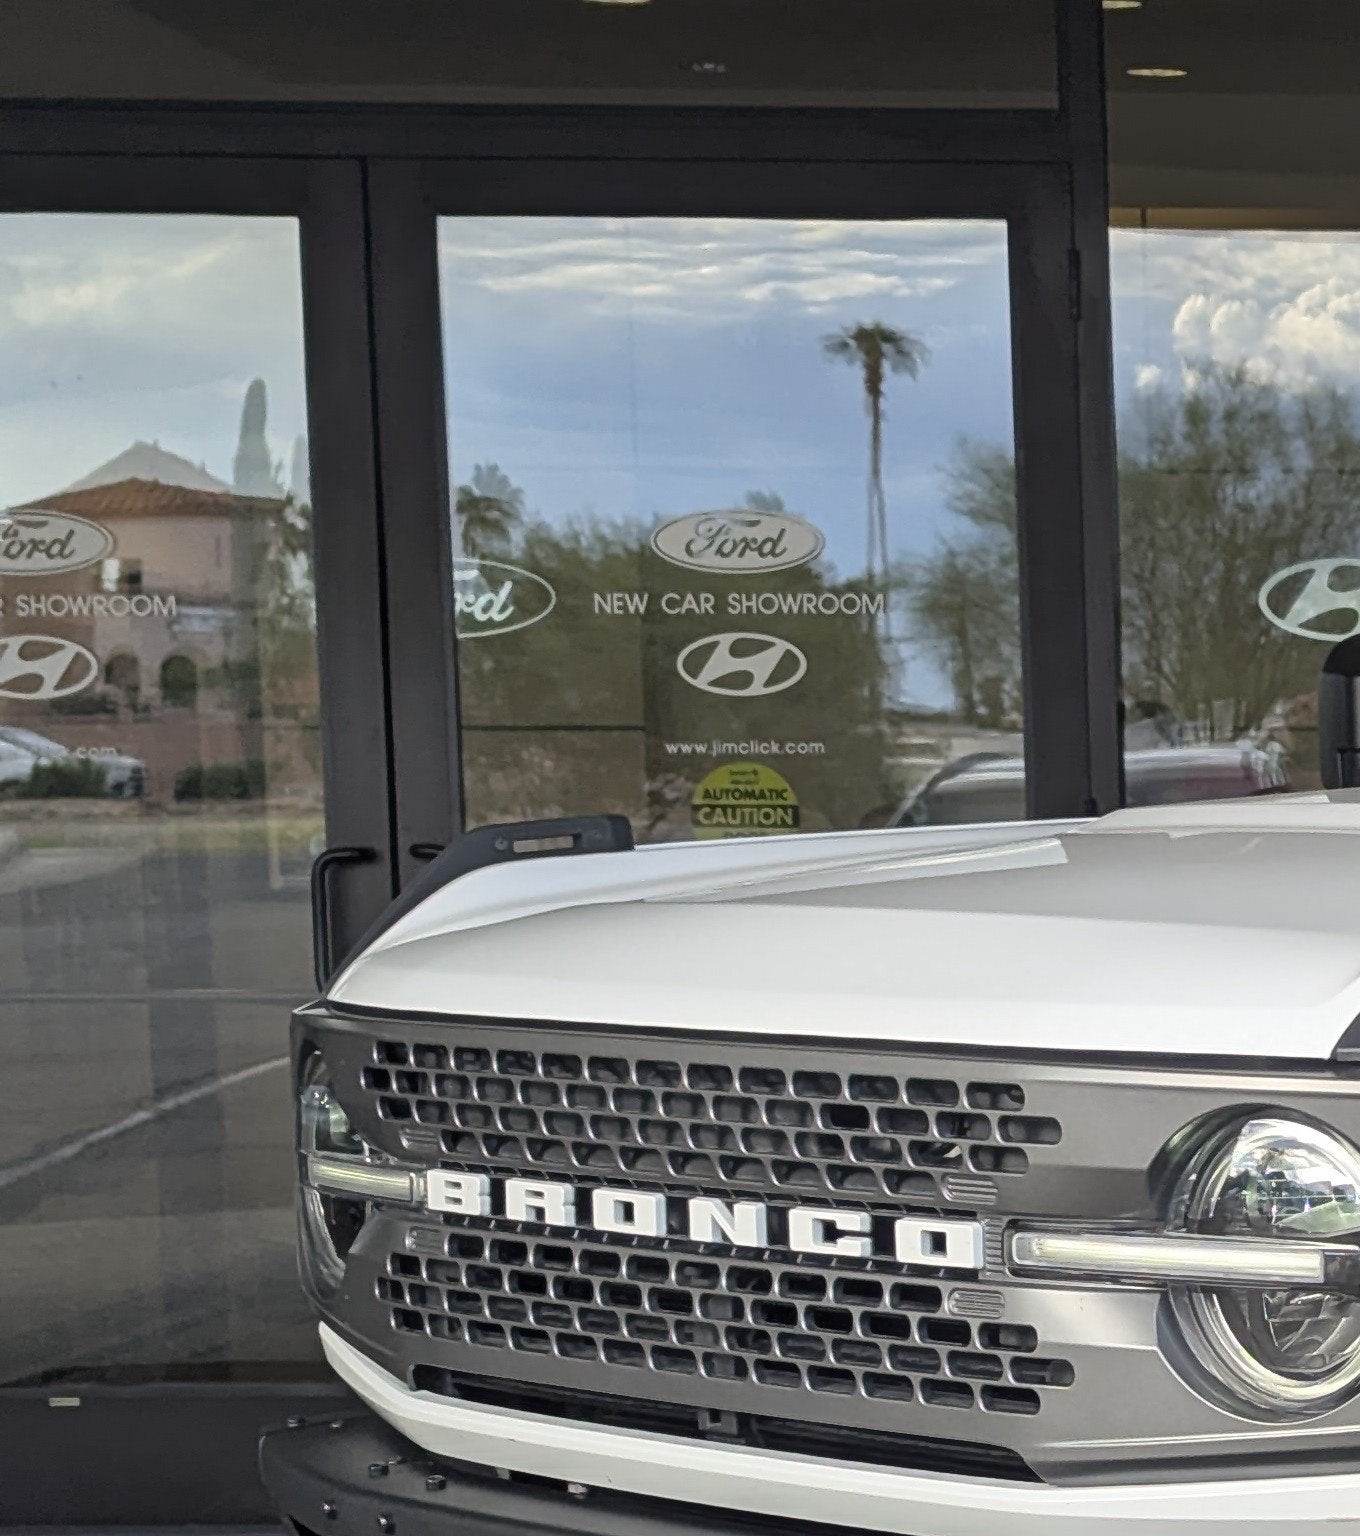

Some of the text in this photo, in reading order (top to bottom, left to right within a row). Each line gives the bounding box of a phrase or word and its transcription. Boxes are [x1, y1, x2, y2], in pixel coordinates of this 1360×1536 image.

[684, 517, 788, 560] Ford
[16, 594, 177, 618] SHOWROOM
[593, 592, 886, 616] NEW CAR SHOWROOM
[665, 739, 826, 758] www.jimclick.com
[702, 787, 789, 801] AUTOMATIC
[697, 806, 794, 827] CAUTION
[425, 1168, 985, 1271] BRONCO
